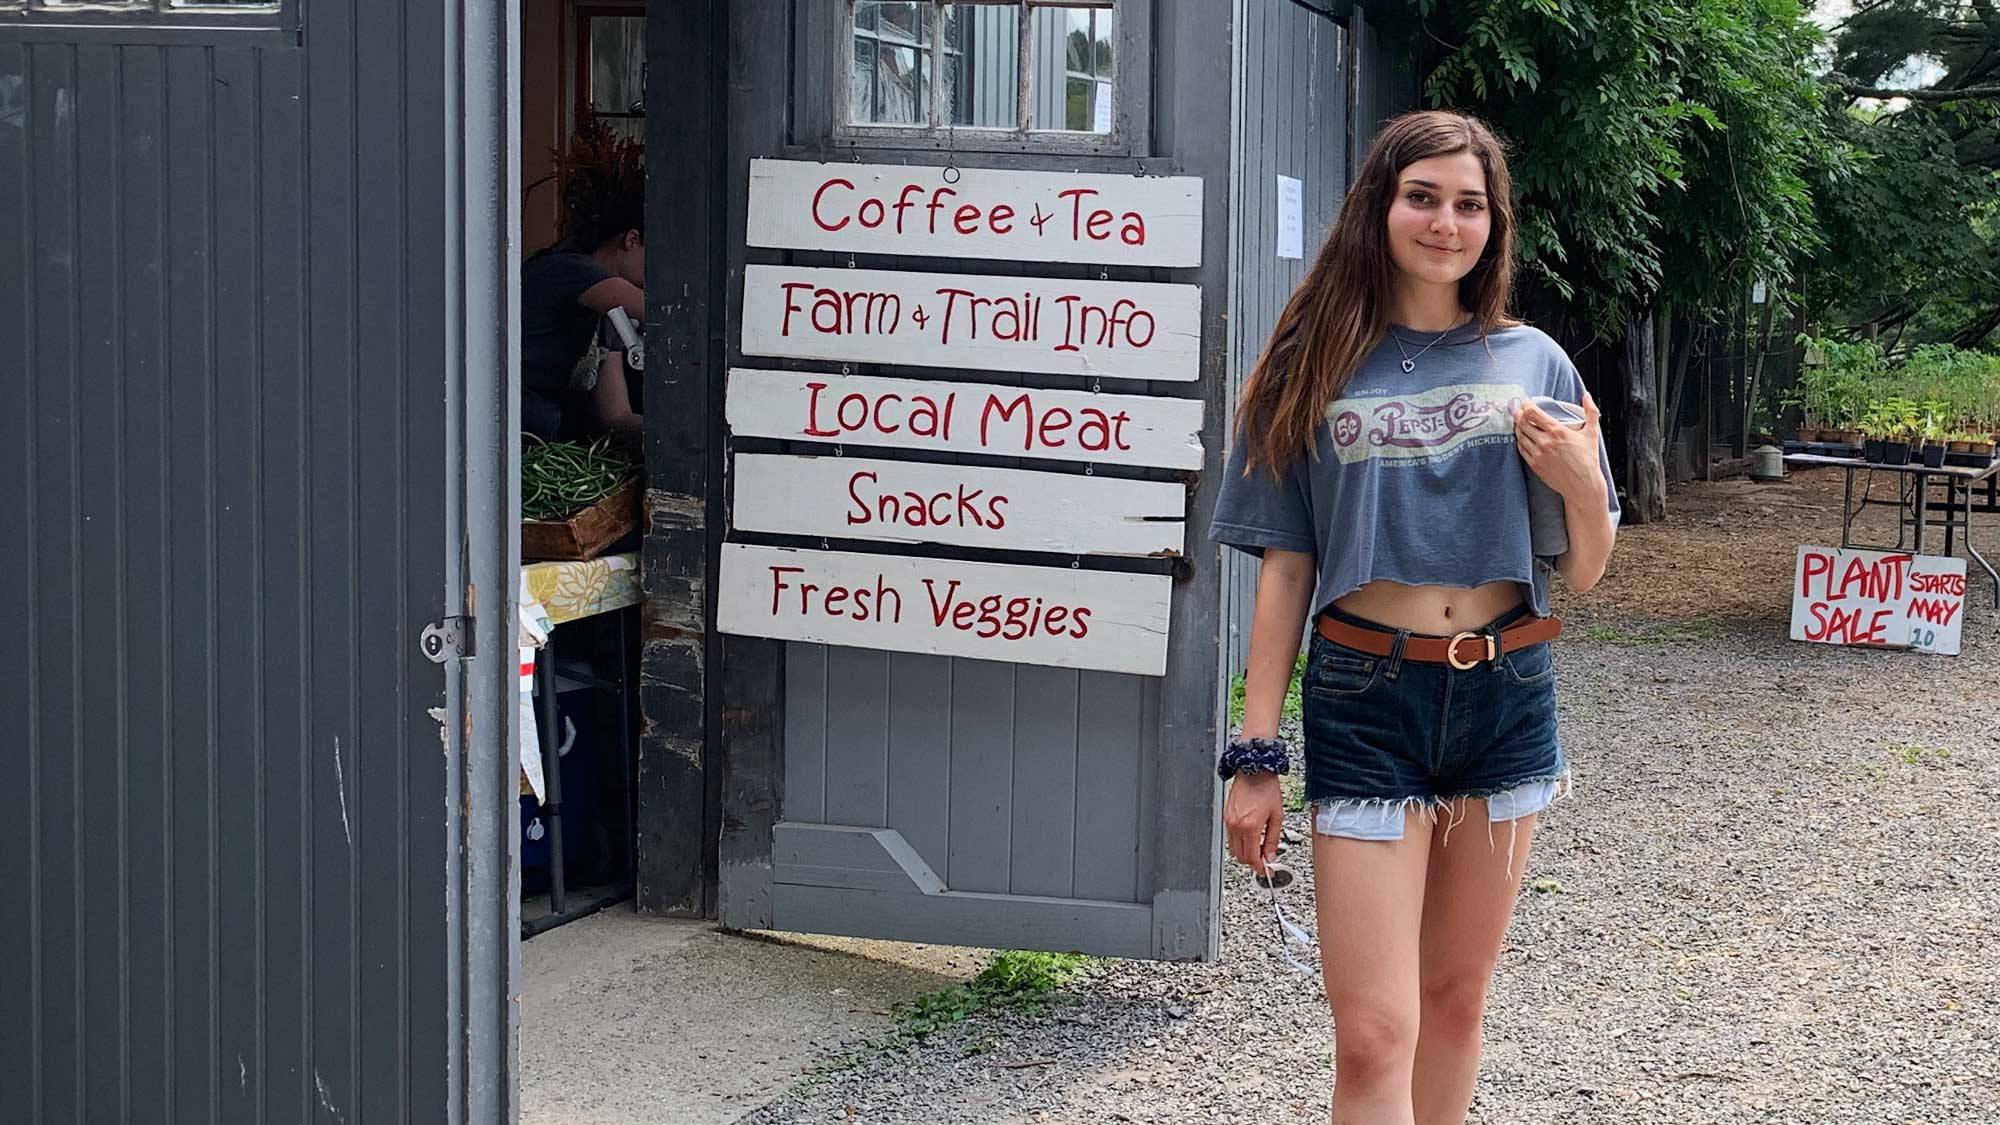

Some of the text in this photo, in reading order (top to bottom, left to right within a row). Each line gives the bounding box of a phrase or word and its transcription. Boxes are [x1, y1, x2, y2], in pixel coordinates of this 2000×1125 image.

[812, 178, 1146, 246] Coffee & Tea
[780, 282, 1156, 352] Farm & Trail Info
[803, 382, 1131, 452] Local Meat
[846, 471, 1009, 530] Snacks
[769, 566, 1092, 641] Fresh Veggies
[1802, 553, 1913, 603] PLANT
[1909, 572, 1967, 597] STARTS
[1804, 602, 1893, 643] SALE
[1906, 598, 1960, 626] MAY
[1910, 627, 1935, 647] 10
